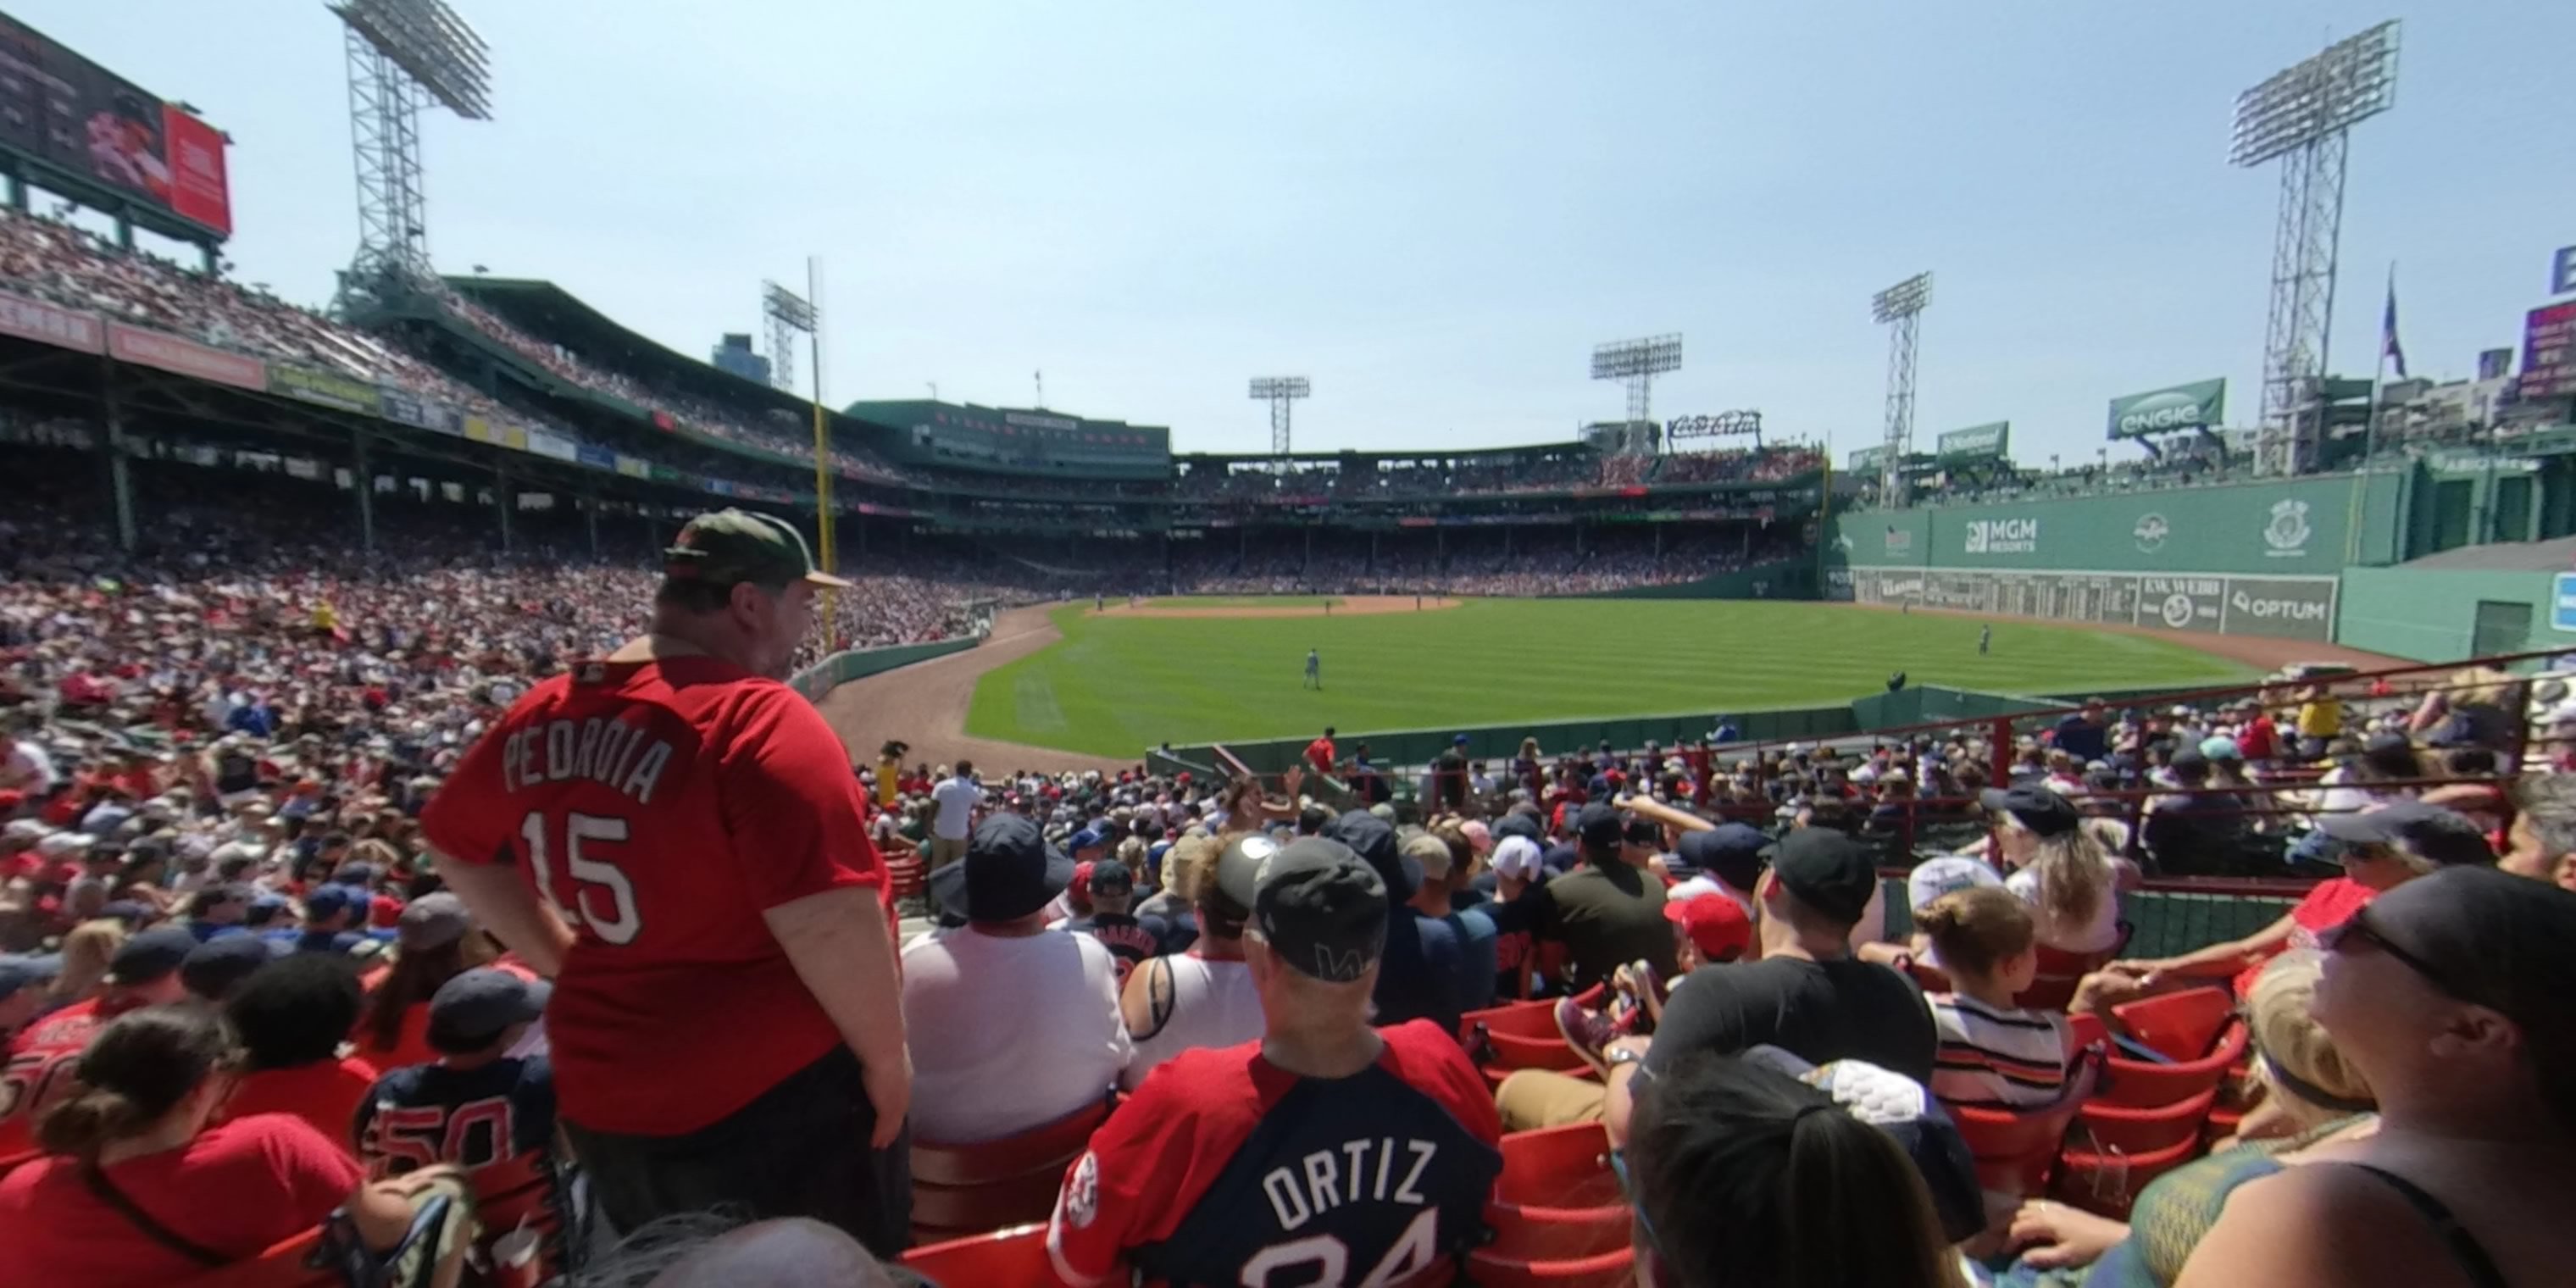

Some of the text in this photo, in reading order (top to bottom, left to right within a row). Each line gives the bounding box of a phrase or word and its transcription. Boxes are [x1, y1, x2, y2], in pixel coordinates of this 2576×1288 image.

[1990, 518, 2036, 540] MGM
[2251, 598, 2326, 620] OPTUM
[502, 717, 674, 804] PEDROIA
[521, 812, 641, 945] 15
[367, 1096, 514, 1180] 50
[1263, 1137, 1436, 1230] ORTIZ
